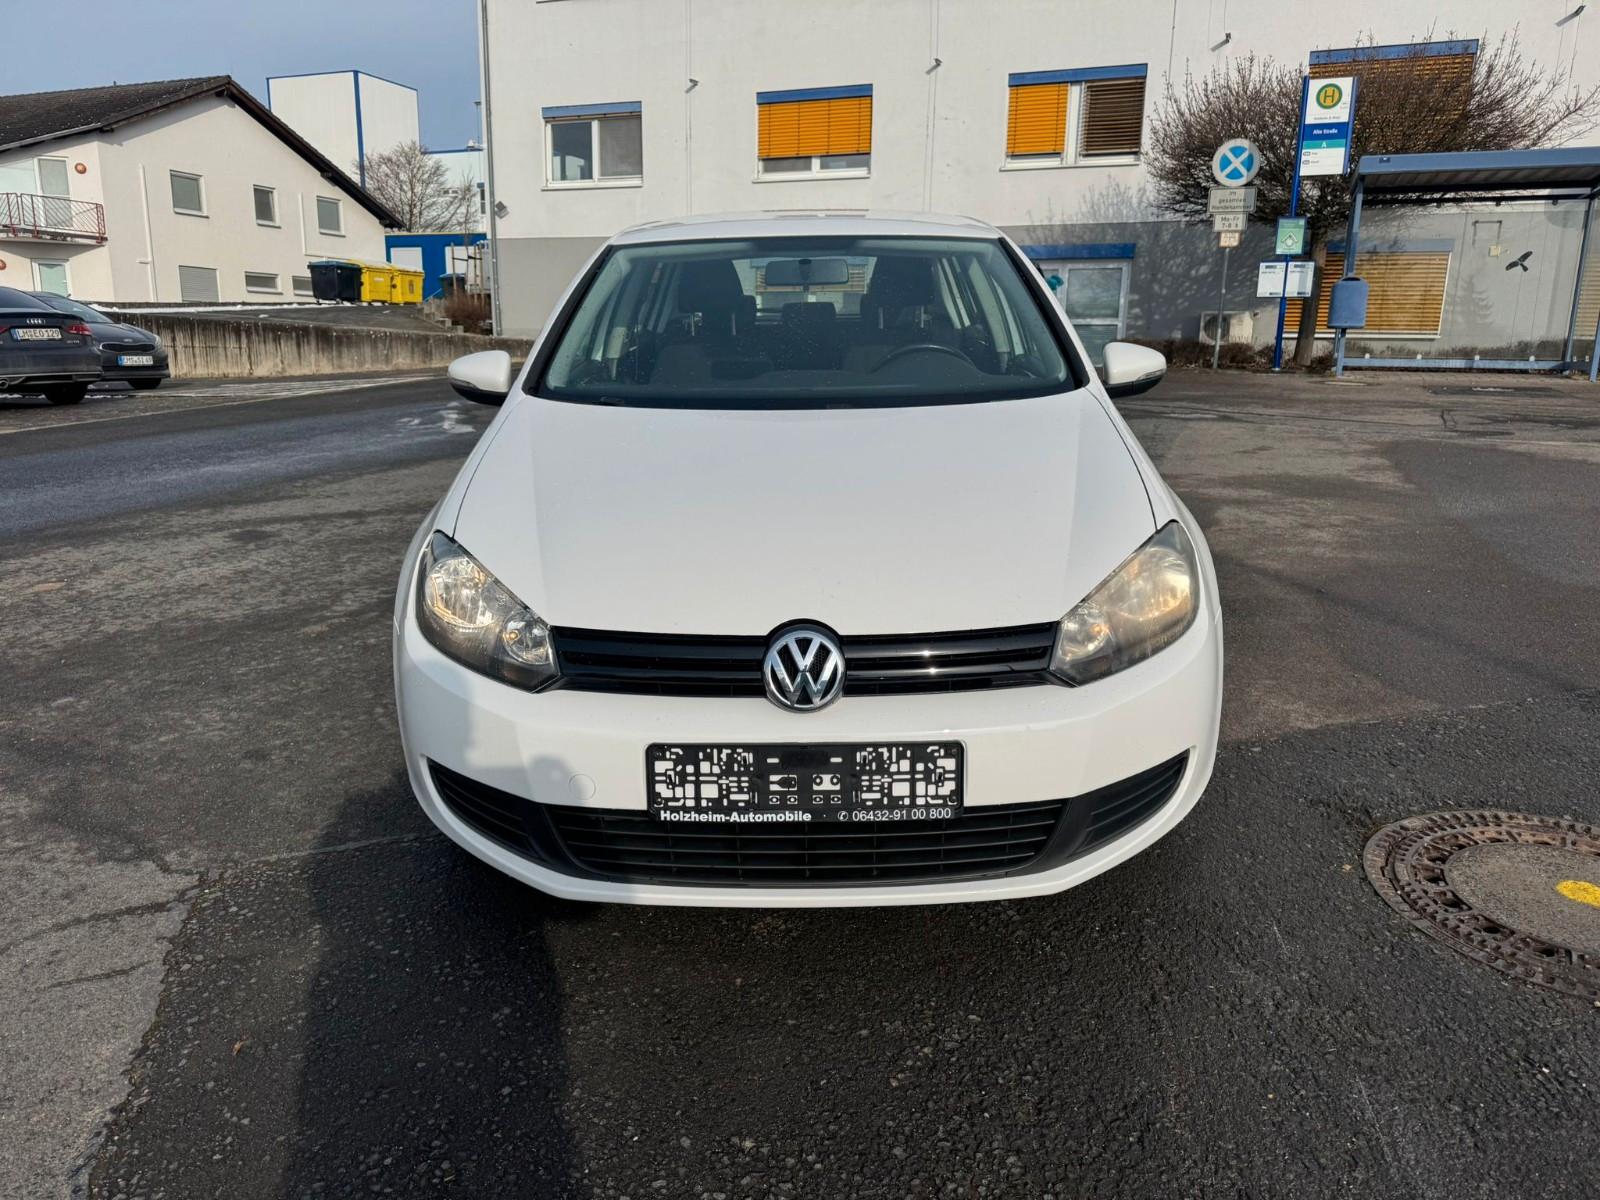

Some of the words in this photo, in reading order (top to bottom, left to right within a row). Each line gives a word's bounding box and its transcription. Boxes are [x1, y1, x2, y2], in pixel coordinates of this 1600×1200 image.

[1323, 89, 1336, 104] H
[660, 810, 812, 822] Holzheim-Automobile
[852, 809, 907, 822] 06432-91
[911, 809, 926, 820] 00
[929, 808, 951, 819] 800
